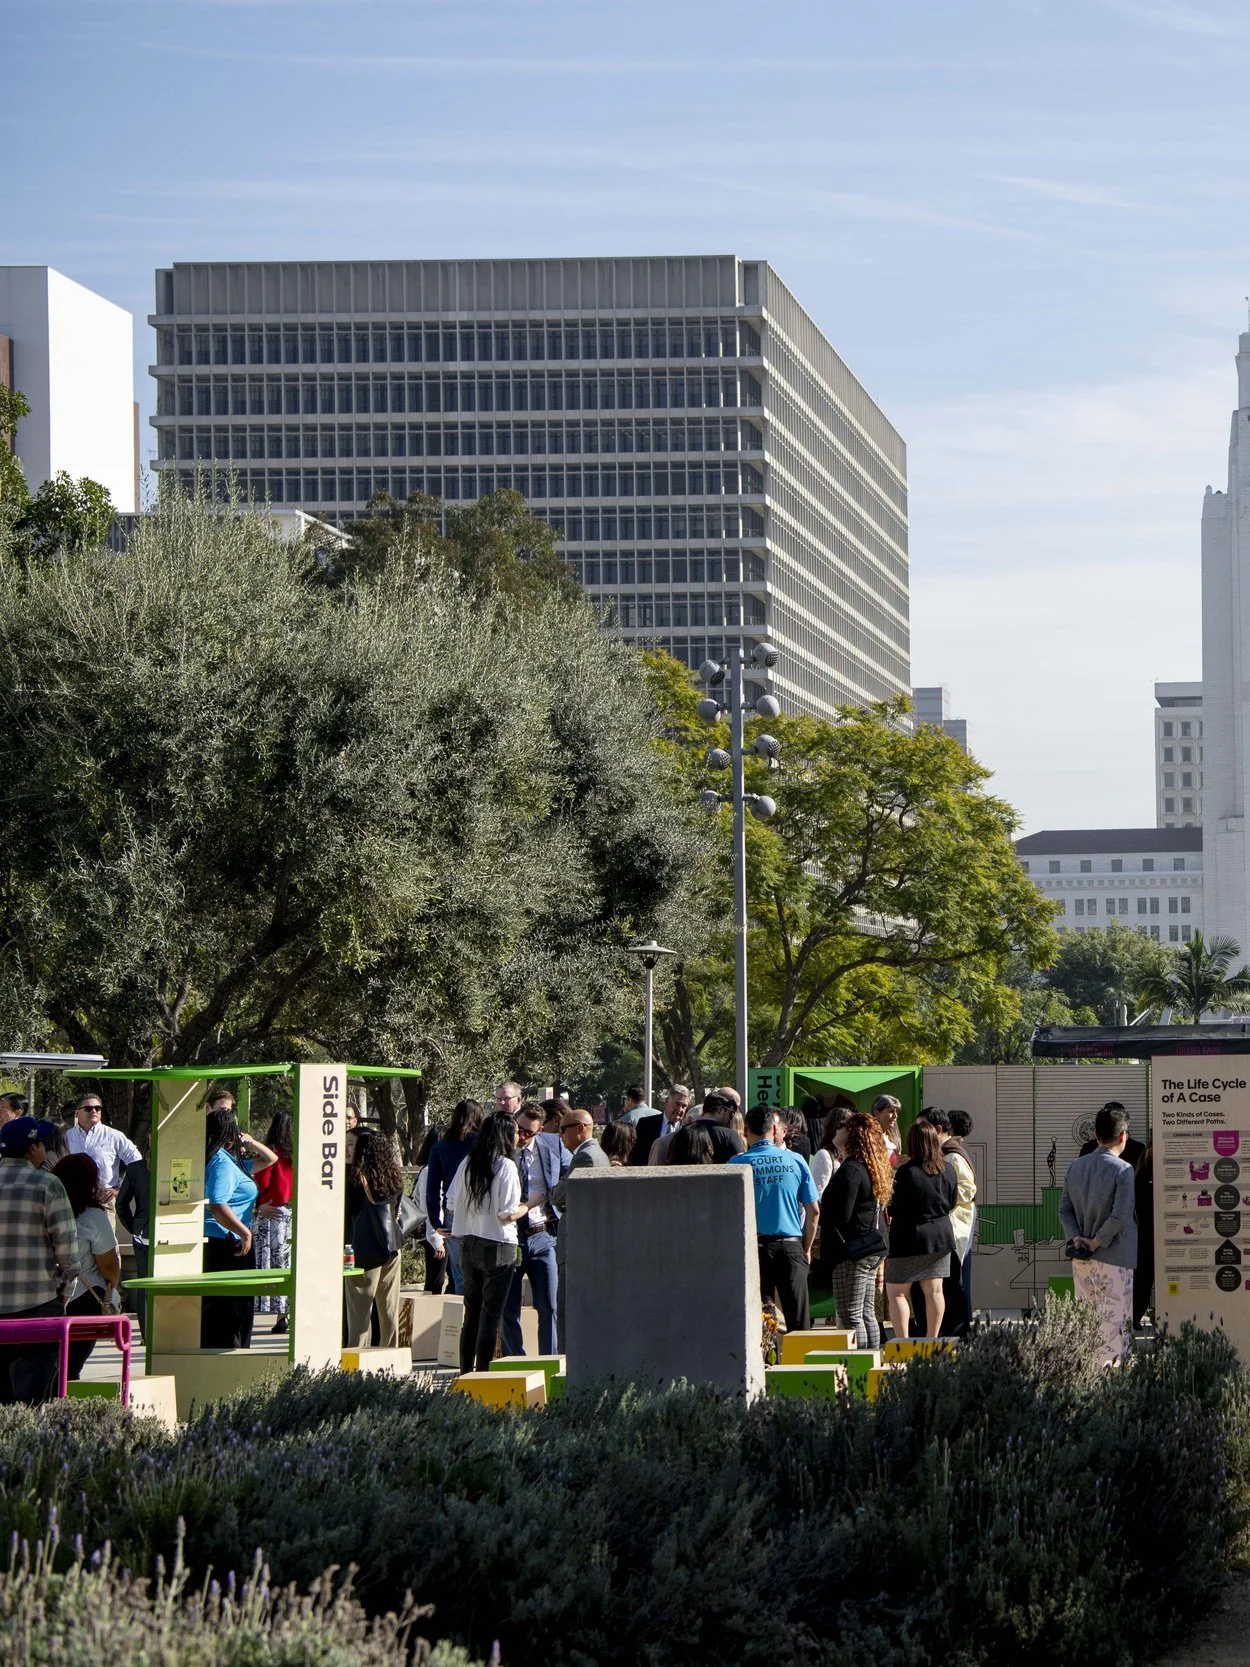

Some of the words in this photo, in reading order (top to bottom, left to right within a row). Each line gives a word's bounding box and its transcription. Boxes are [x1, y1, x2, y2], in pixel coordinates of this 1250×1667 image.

[1161, 1079, 1184, 1090] The
[1187, 1079, 1209, 1089] Life
[1212, 1078, 1247, 1091] Cycle
[1161, 1092, 1174, 1103] of
[1176, 1092, 1186, 1103] A
[1189, 1092, 1221, 1103] Case
[322, 1075, 339, 1136] Side
[321, 1142, 338, 1190] Bar
[750, 1156, 783, 1166] COURT
[753, 1165, 794, 1176] MMONS
[756, 1175, 783, 1185] STAFF
